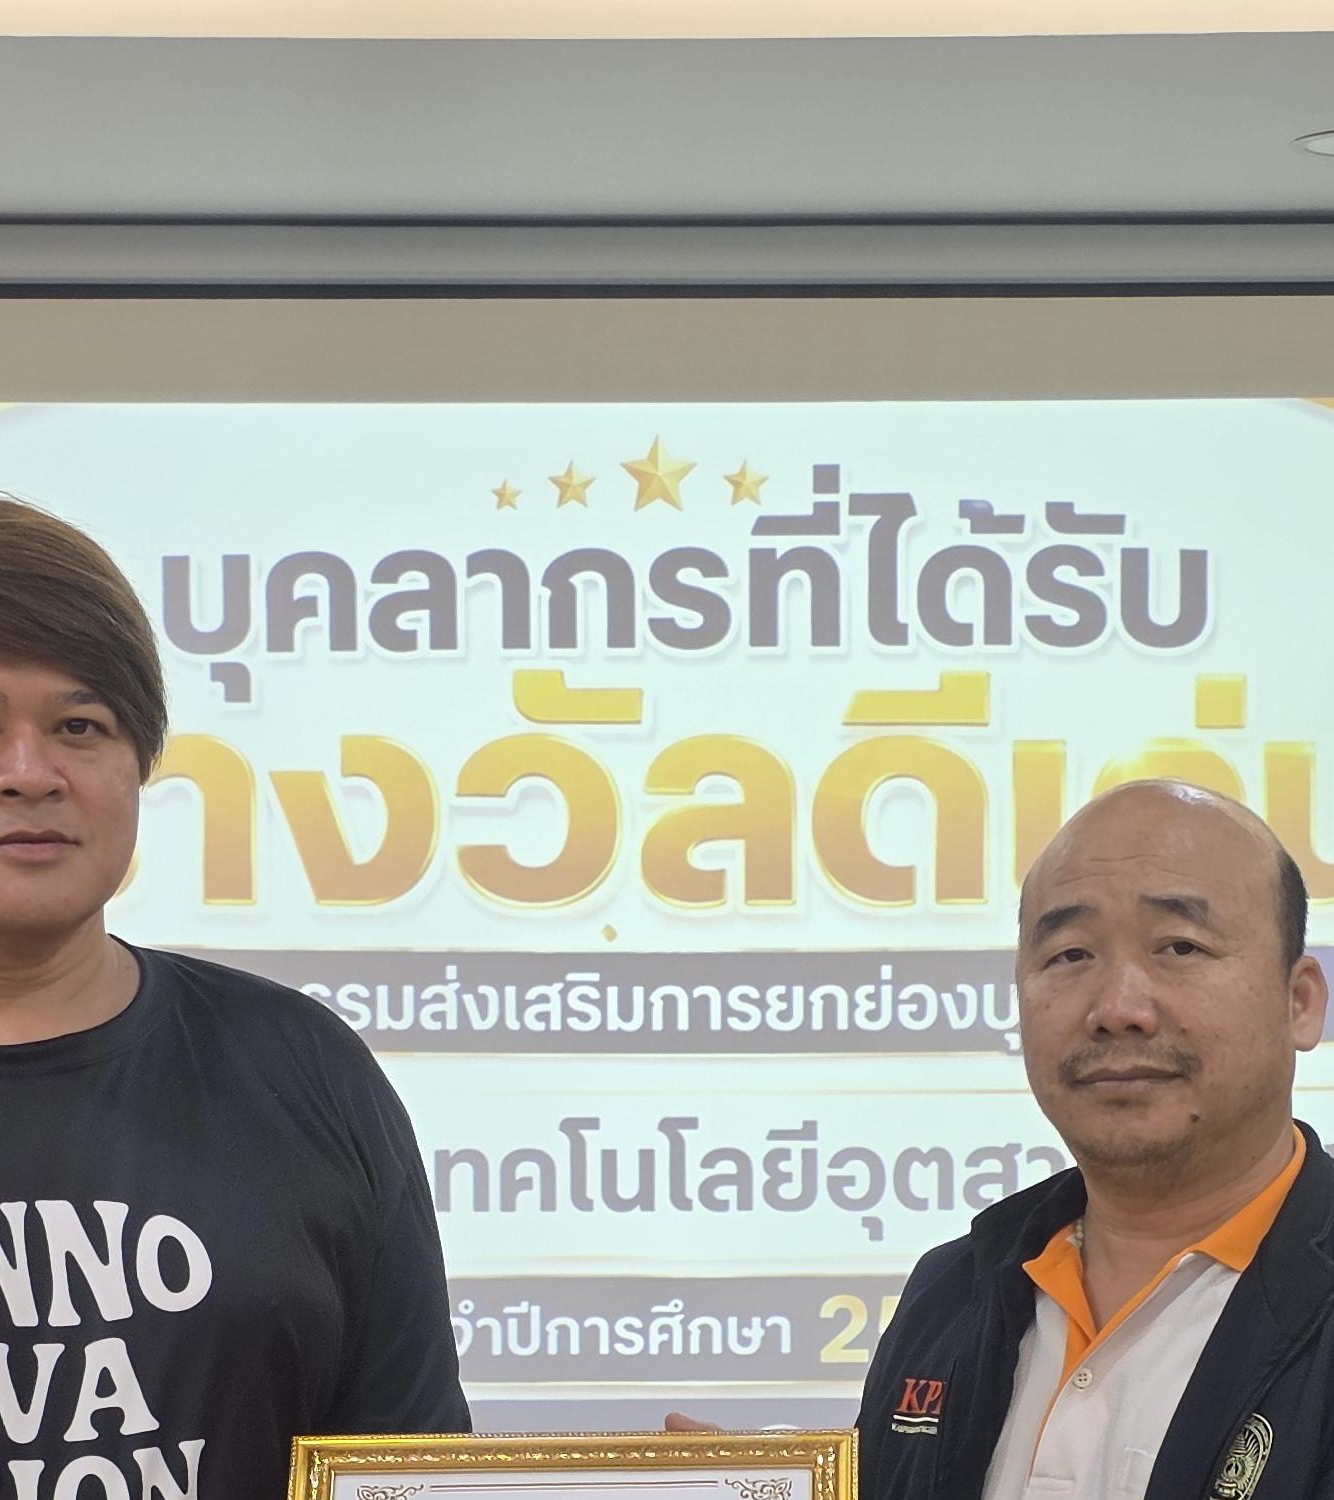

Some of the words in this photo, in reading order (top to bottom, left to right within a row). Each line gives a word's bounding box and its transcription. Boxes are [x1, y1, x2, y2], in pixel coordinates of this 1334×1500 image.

[160, 463, 1208, 703] บุคลากรที่ได้รับ
[451, 1298, 792, 1357] จำปีการศึกษา
